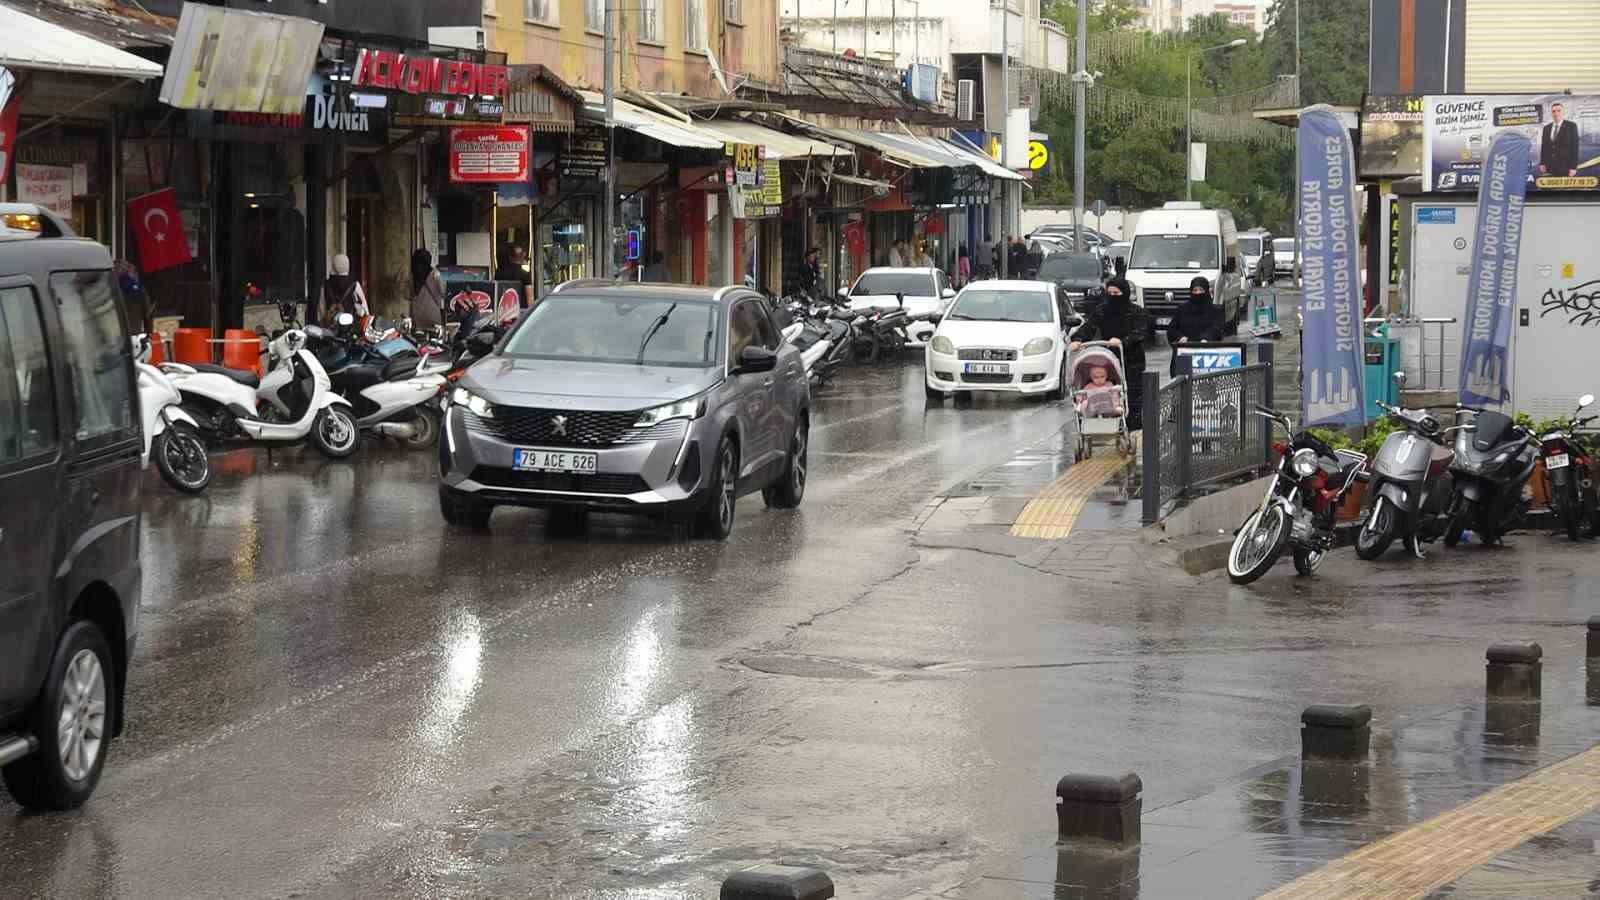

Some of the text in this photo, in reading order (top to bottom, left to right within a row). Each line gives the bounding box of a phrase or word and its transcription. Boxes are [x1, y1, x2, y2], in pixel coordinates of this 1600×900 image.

[521, 452, 594, 469] 79 ACE 626
